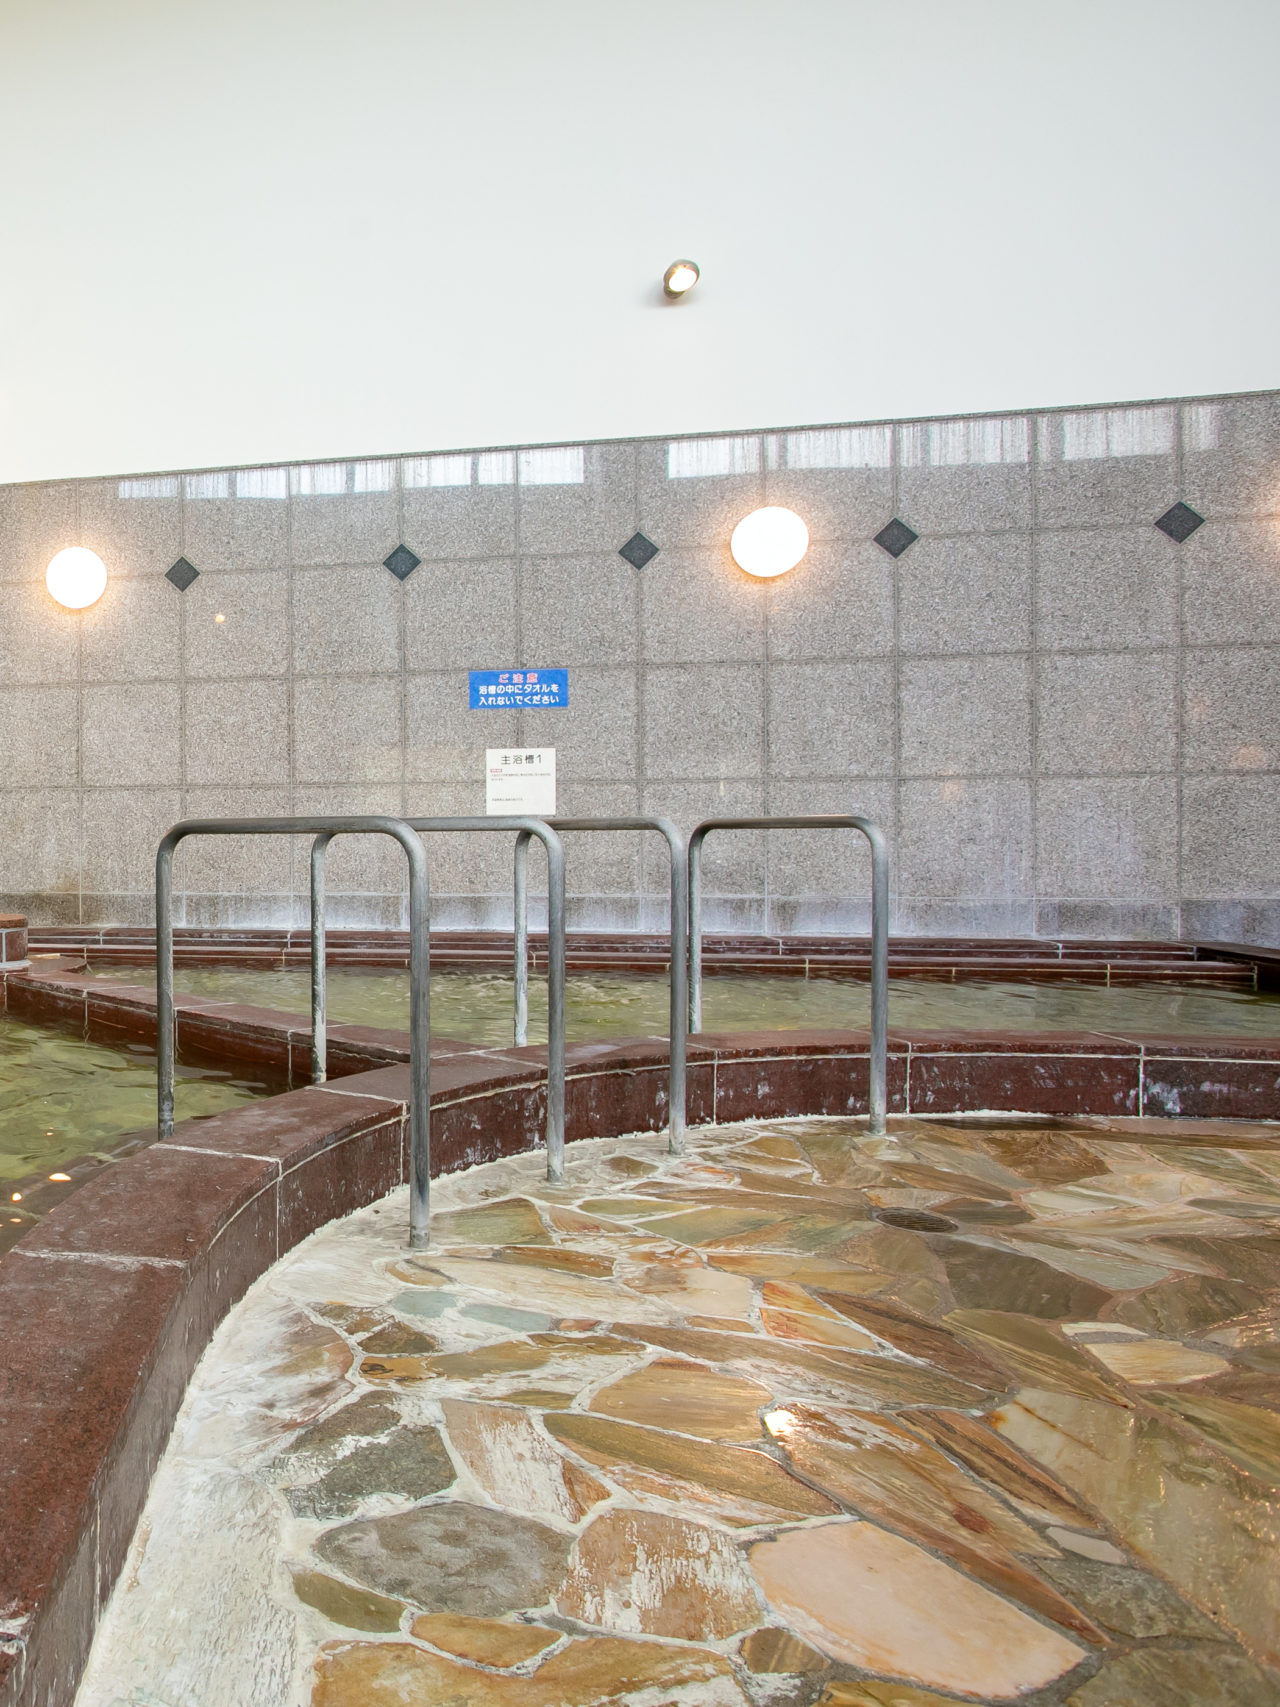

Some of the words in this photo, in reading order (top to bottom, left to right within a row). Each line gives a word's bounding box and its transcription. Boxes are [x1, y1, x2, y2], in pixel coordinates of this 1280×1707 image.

[479, 684, 559, 695] 浴槽の中にタオルを
[479, 695, 560, 706] 入れないでください
